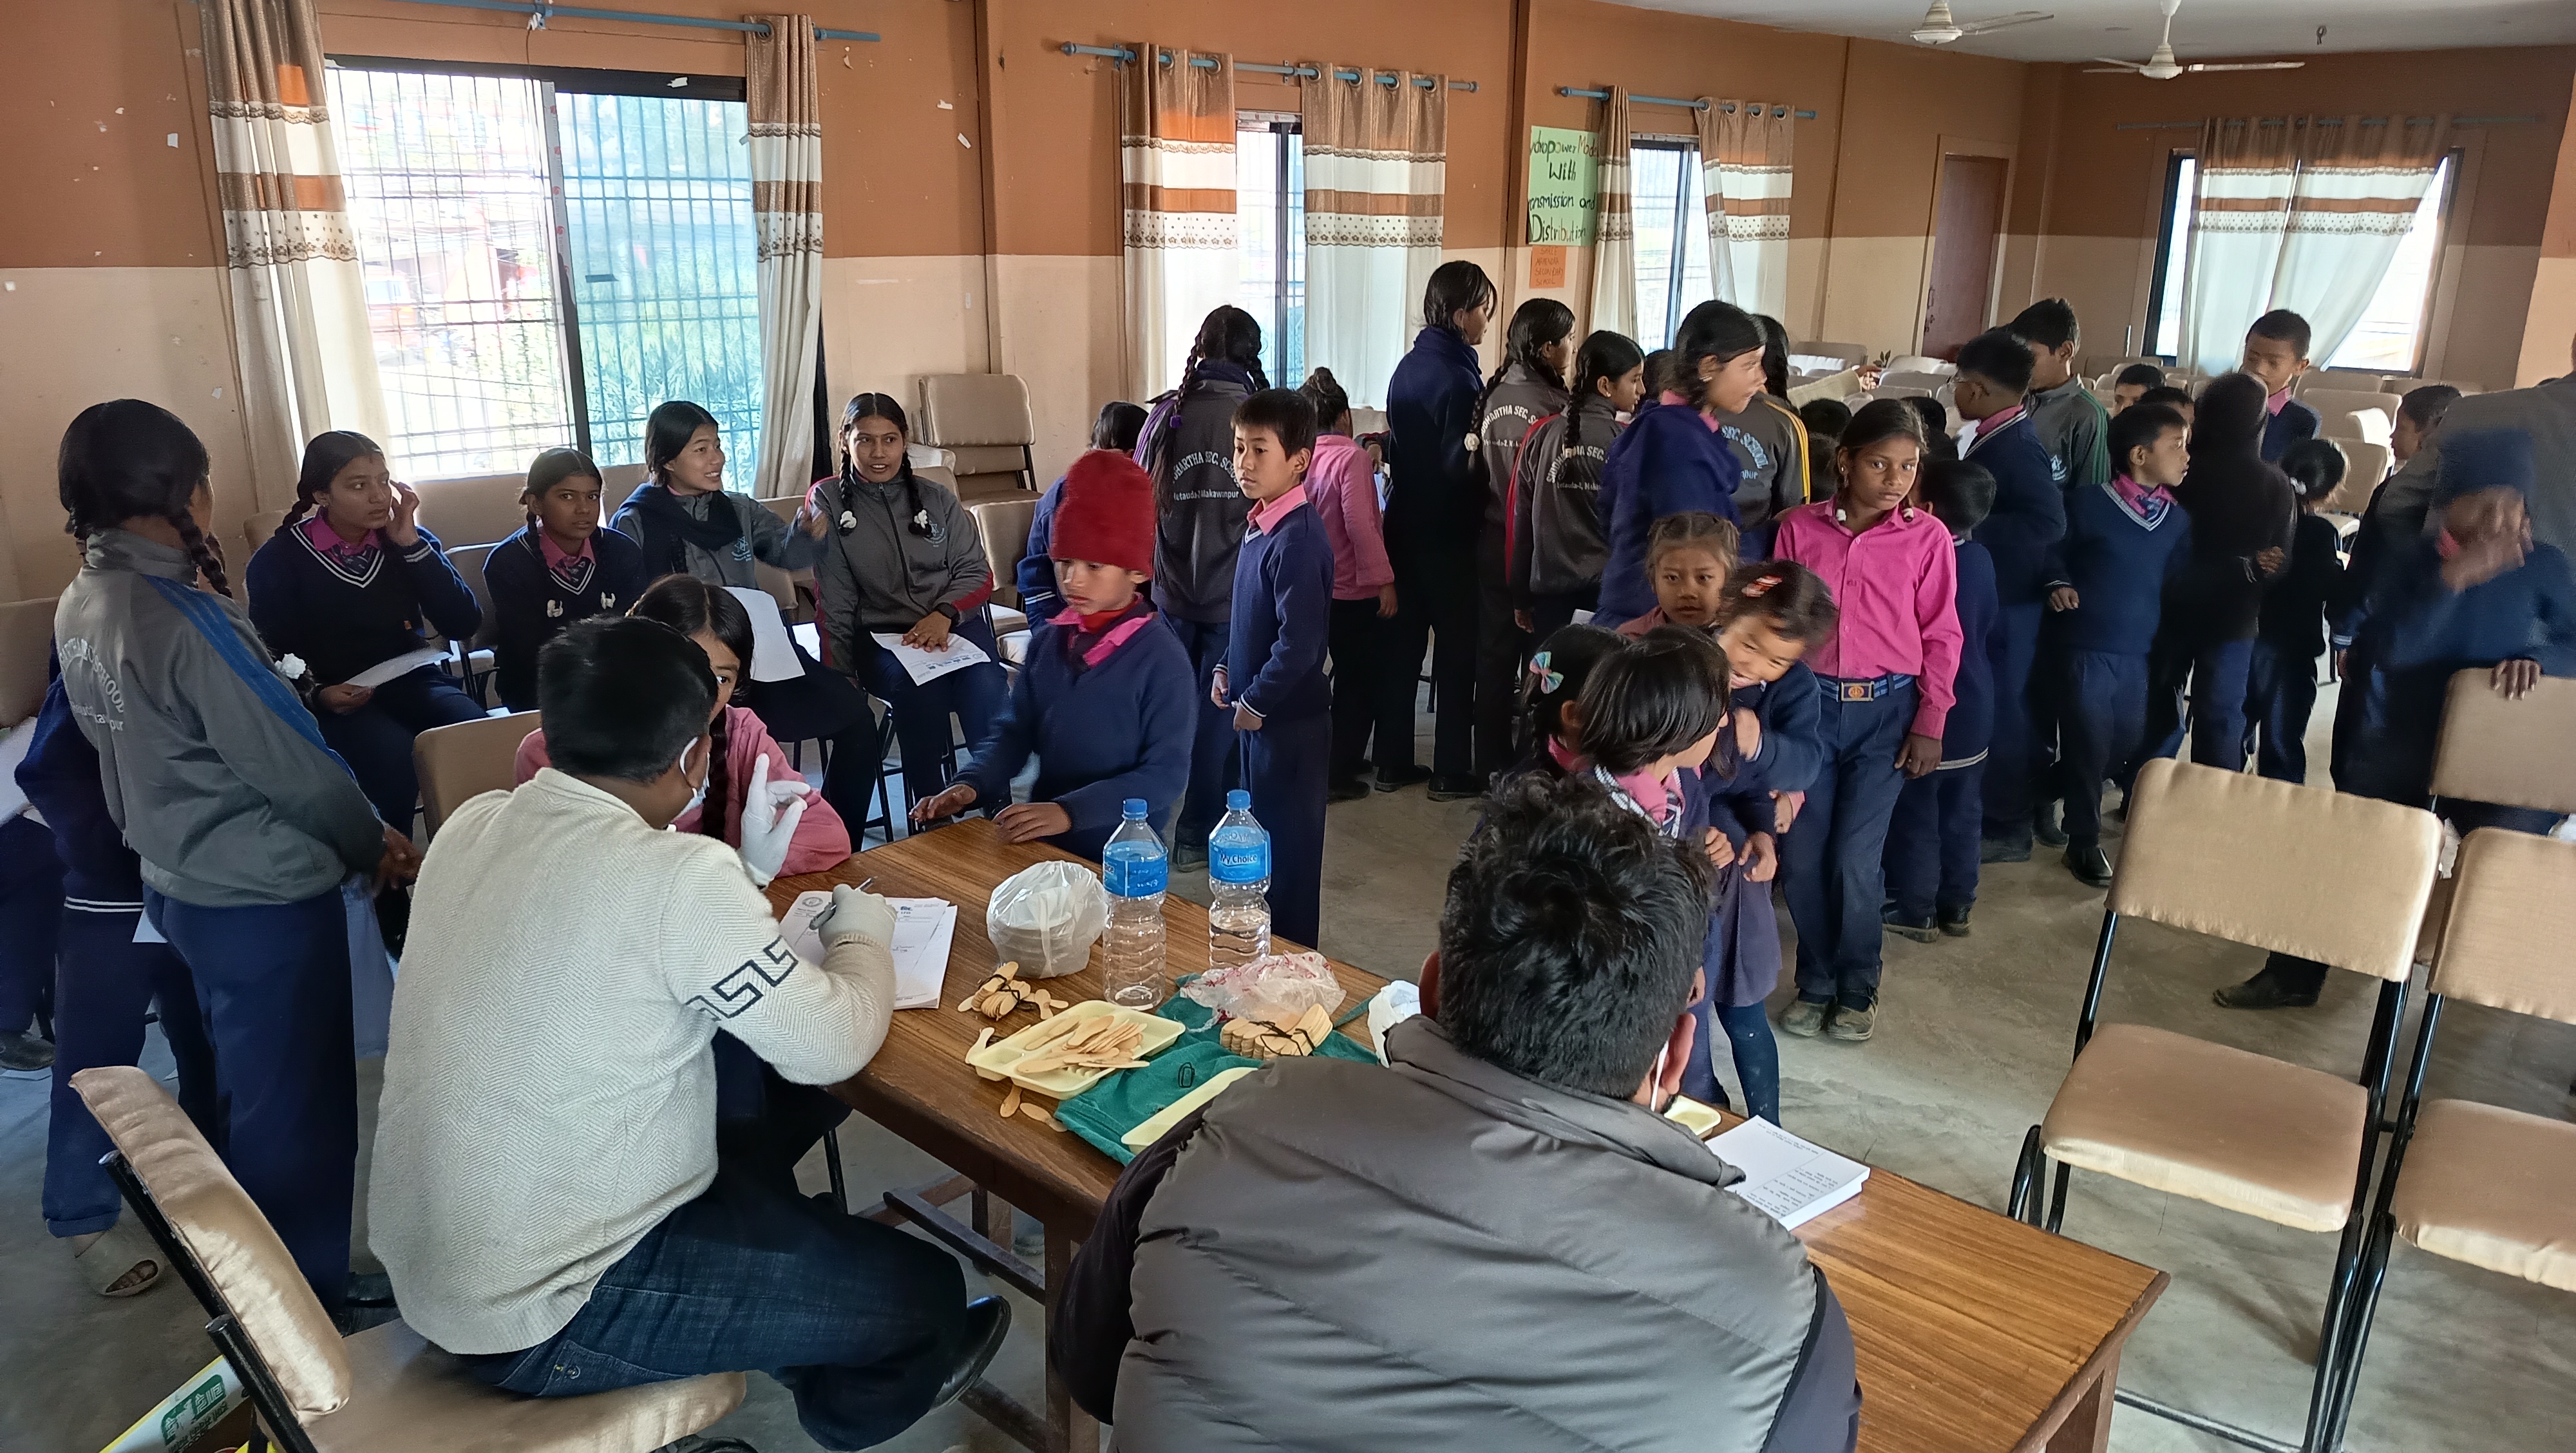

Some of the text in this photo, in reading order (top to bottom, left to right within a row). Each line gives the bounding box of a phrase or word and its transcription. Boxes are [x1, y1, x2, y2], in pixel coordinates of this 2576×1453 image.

[1549, 158, 1577, 182] With
[1579, 192, 1596, 210] and
[1532, 214, 1586, 243] Distribution
[1220, 853, 1257, 864] My Choice
